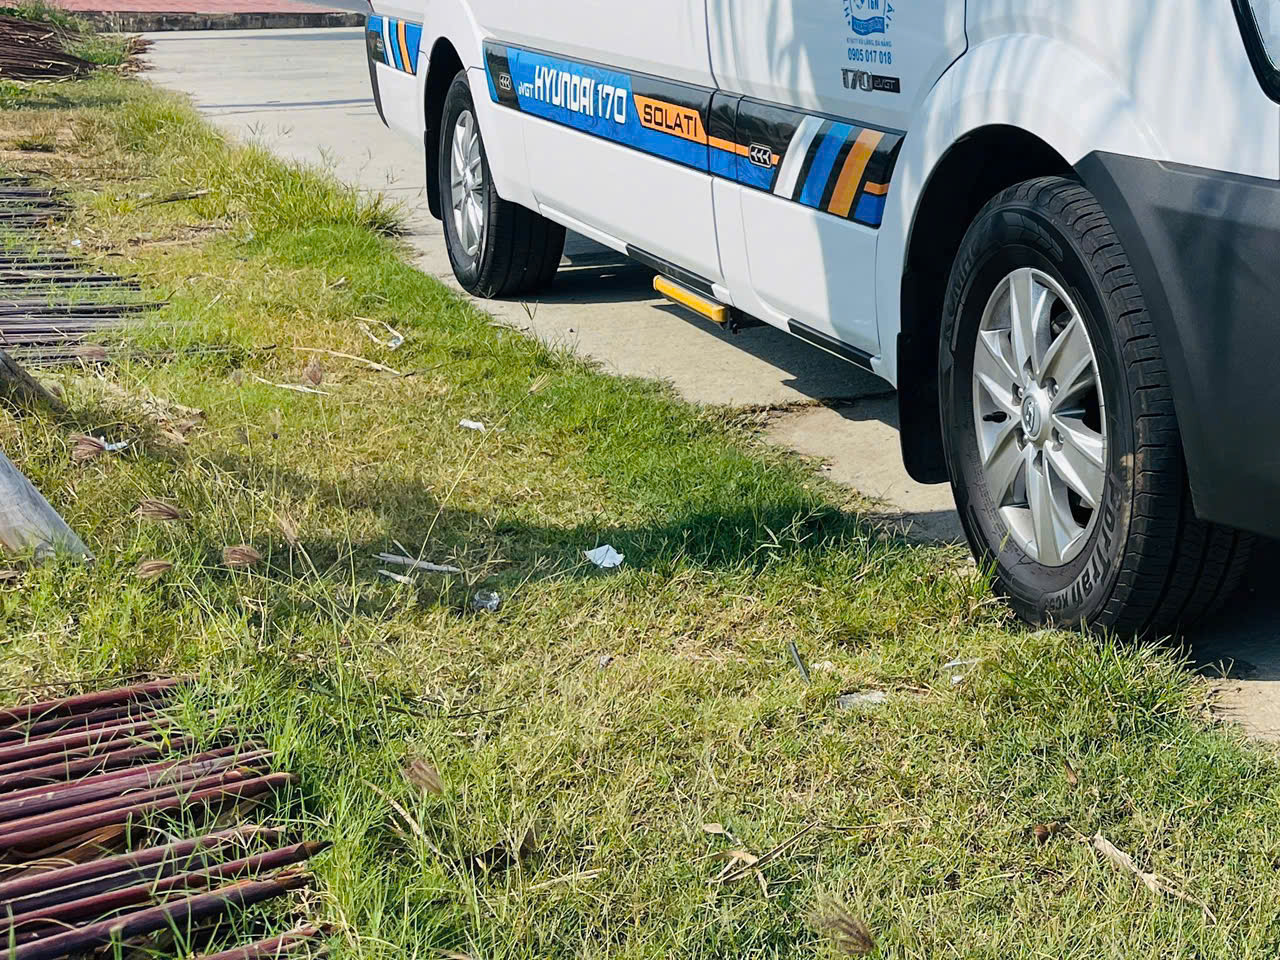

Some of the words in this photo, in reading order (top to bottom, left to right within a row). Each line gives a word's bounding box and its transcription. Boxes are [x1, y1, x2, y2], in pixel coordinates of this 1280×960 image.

[847, 47, 864, 61] 0905
[865, 49, 877, 63] 017
[879, 50, 892, 65] 018
[534, 65, 595, 117] HYUNDAI
[597, 83, 628, 124] 170
[643, 103, 697, 138] SOLATI
